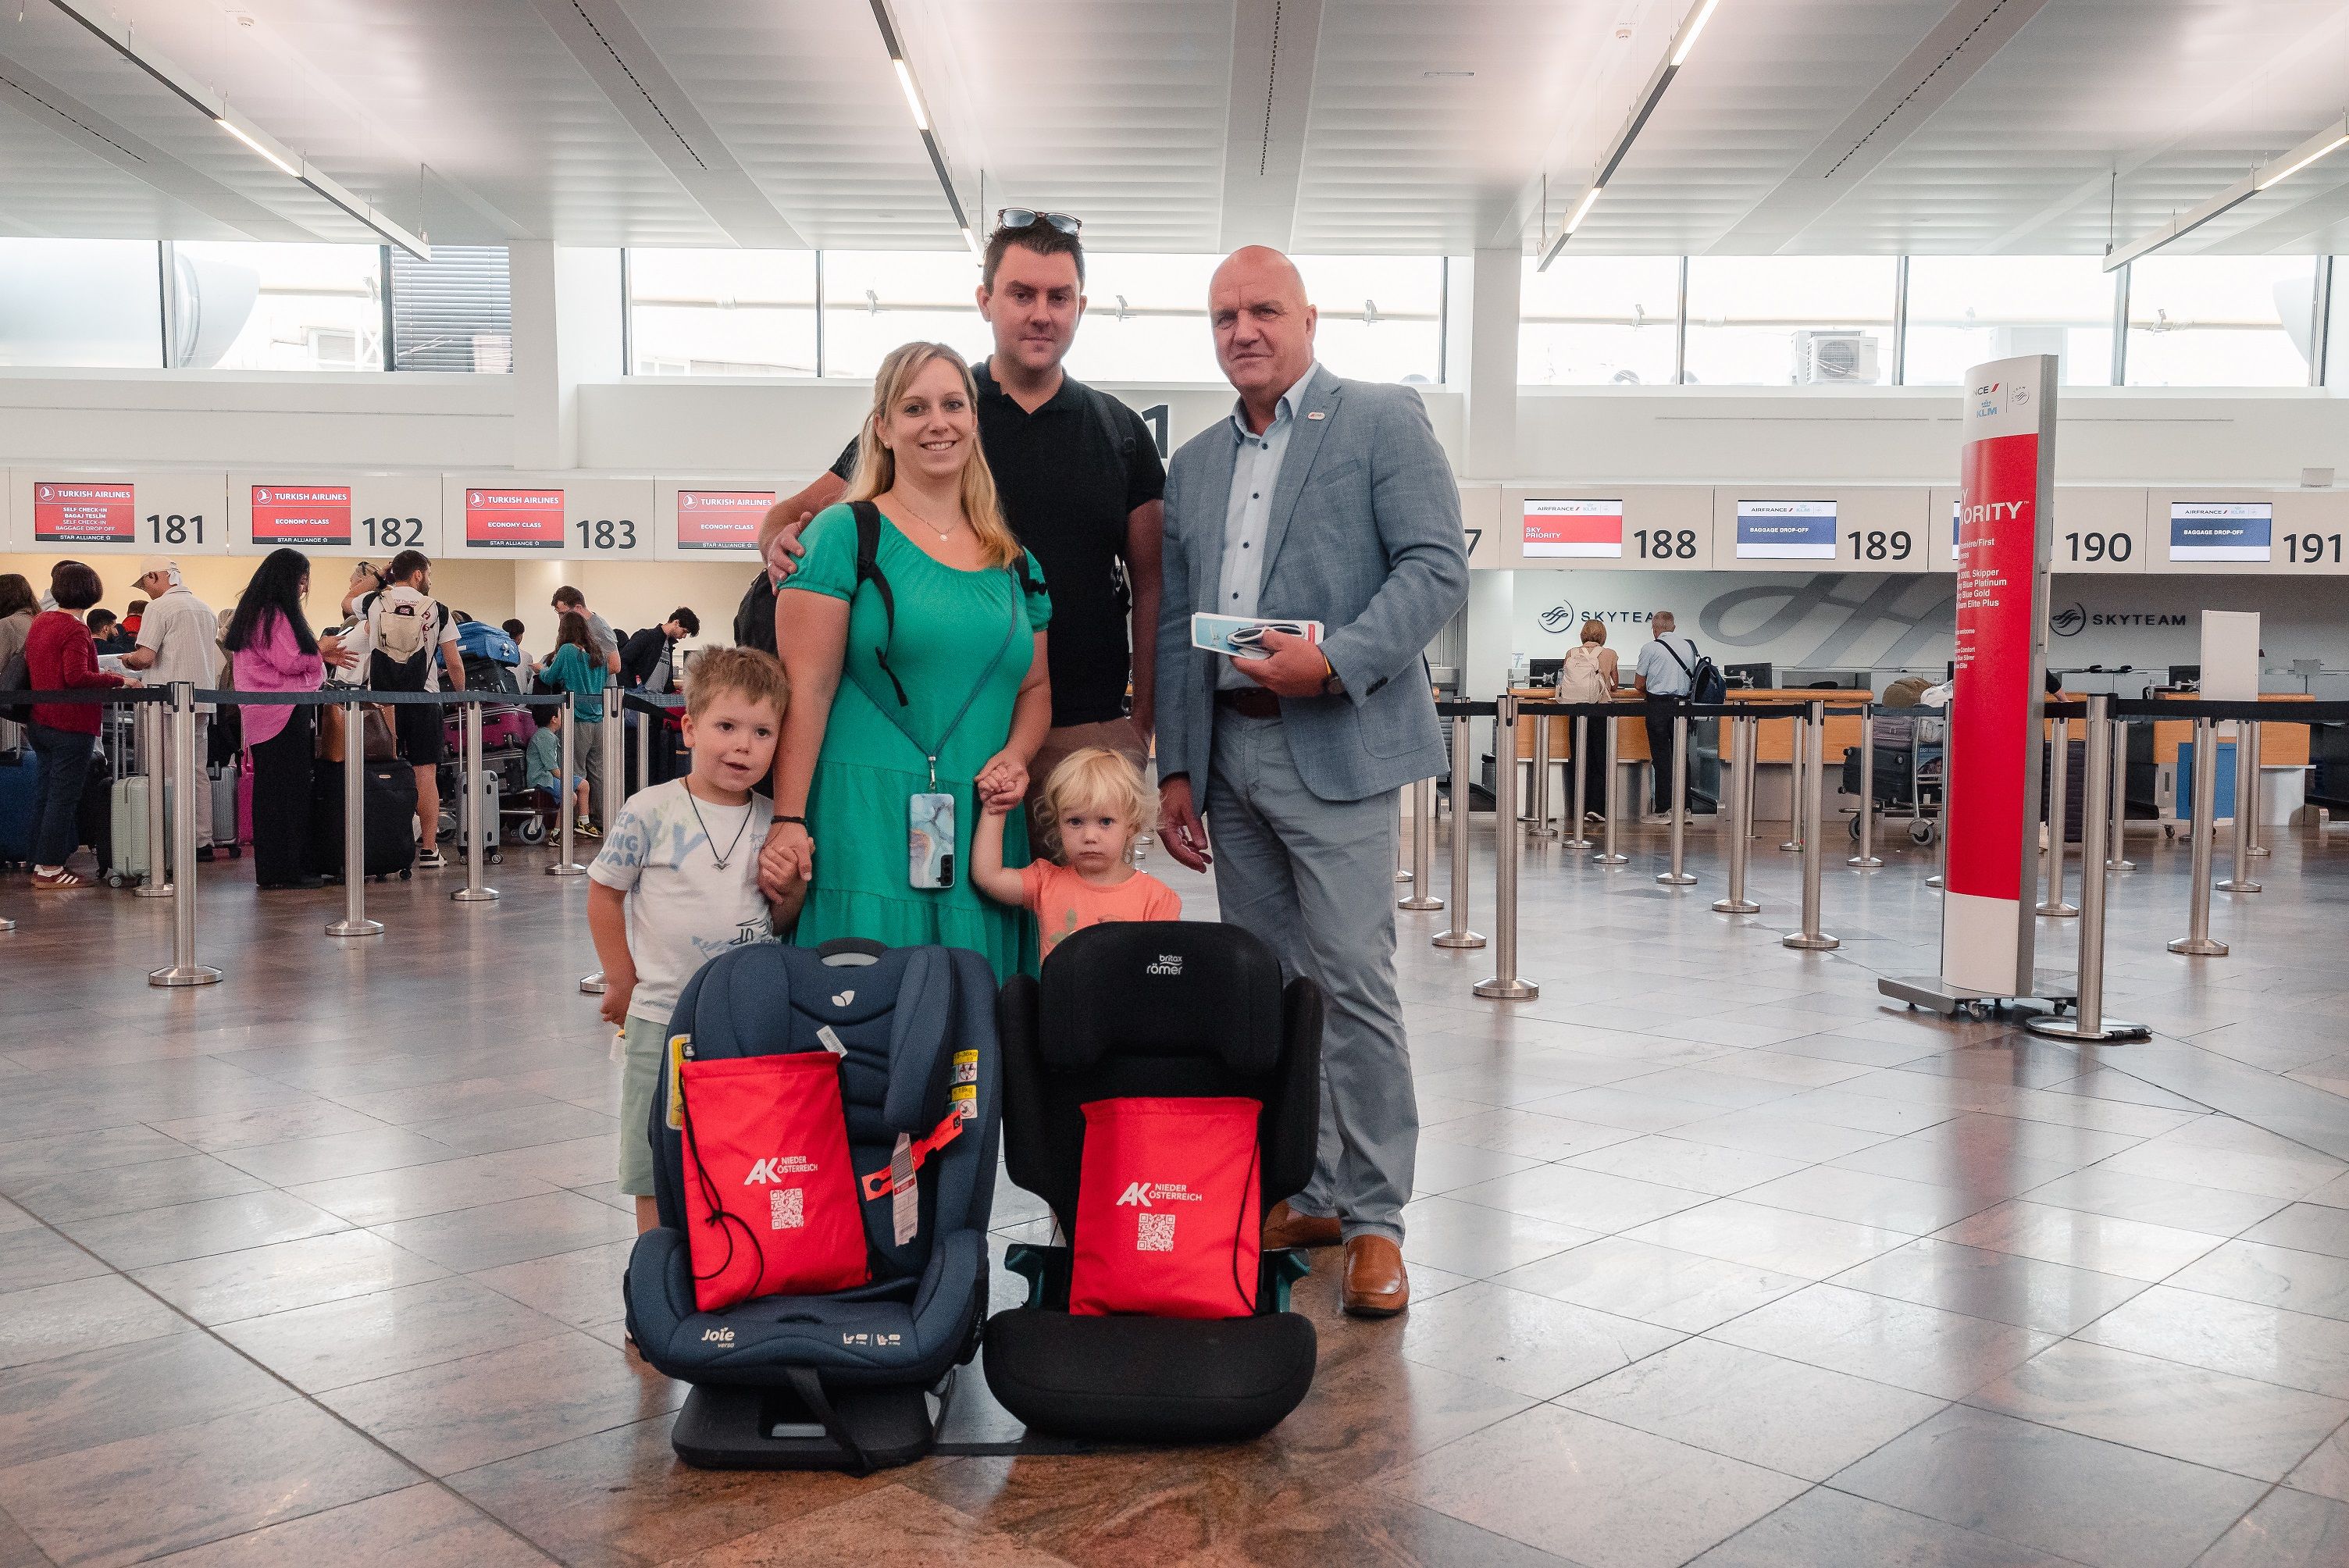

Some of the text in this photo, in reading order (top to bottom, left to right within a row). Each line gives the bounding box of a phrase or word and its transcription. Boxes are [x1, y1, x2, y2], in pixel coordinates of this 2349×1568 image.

[1977, 406, 1998, 419] KLM
[1961, 501, 2023, 526] IORITY
[146, 515, 203, 544] 181
[362, 518, 425, 547] 182
[576, 519, 636, 549] 183
[1633, 529, 1697, 559] 188
[1848, 530, 1912, 561] 189
[2065, 532, 2132, 562] 190
[2283, 533, 2341, 564] 191
[1972, 569, 1999, 579] Skipper
[1974, 579, 2007, 587] Platinum
[1962, 590, 1973, 599] Blue
[1973, 589, 1990, 597] Gold
[1581, 611, 1654, 622] SKYTEA
[2093, 614, 2186, 625] SKYTEAM
[1146, 963, 1183, 975] römer
[743, 1156, 807, 1185] AK NIEDER
[1116, 1181, 1187, 1207] AK NIEDER
[700, 1327, 735, 1342] Joie
